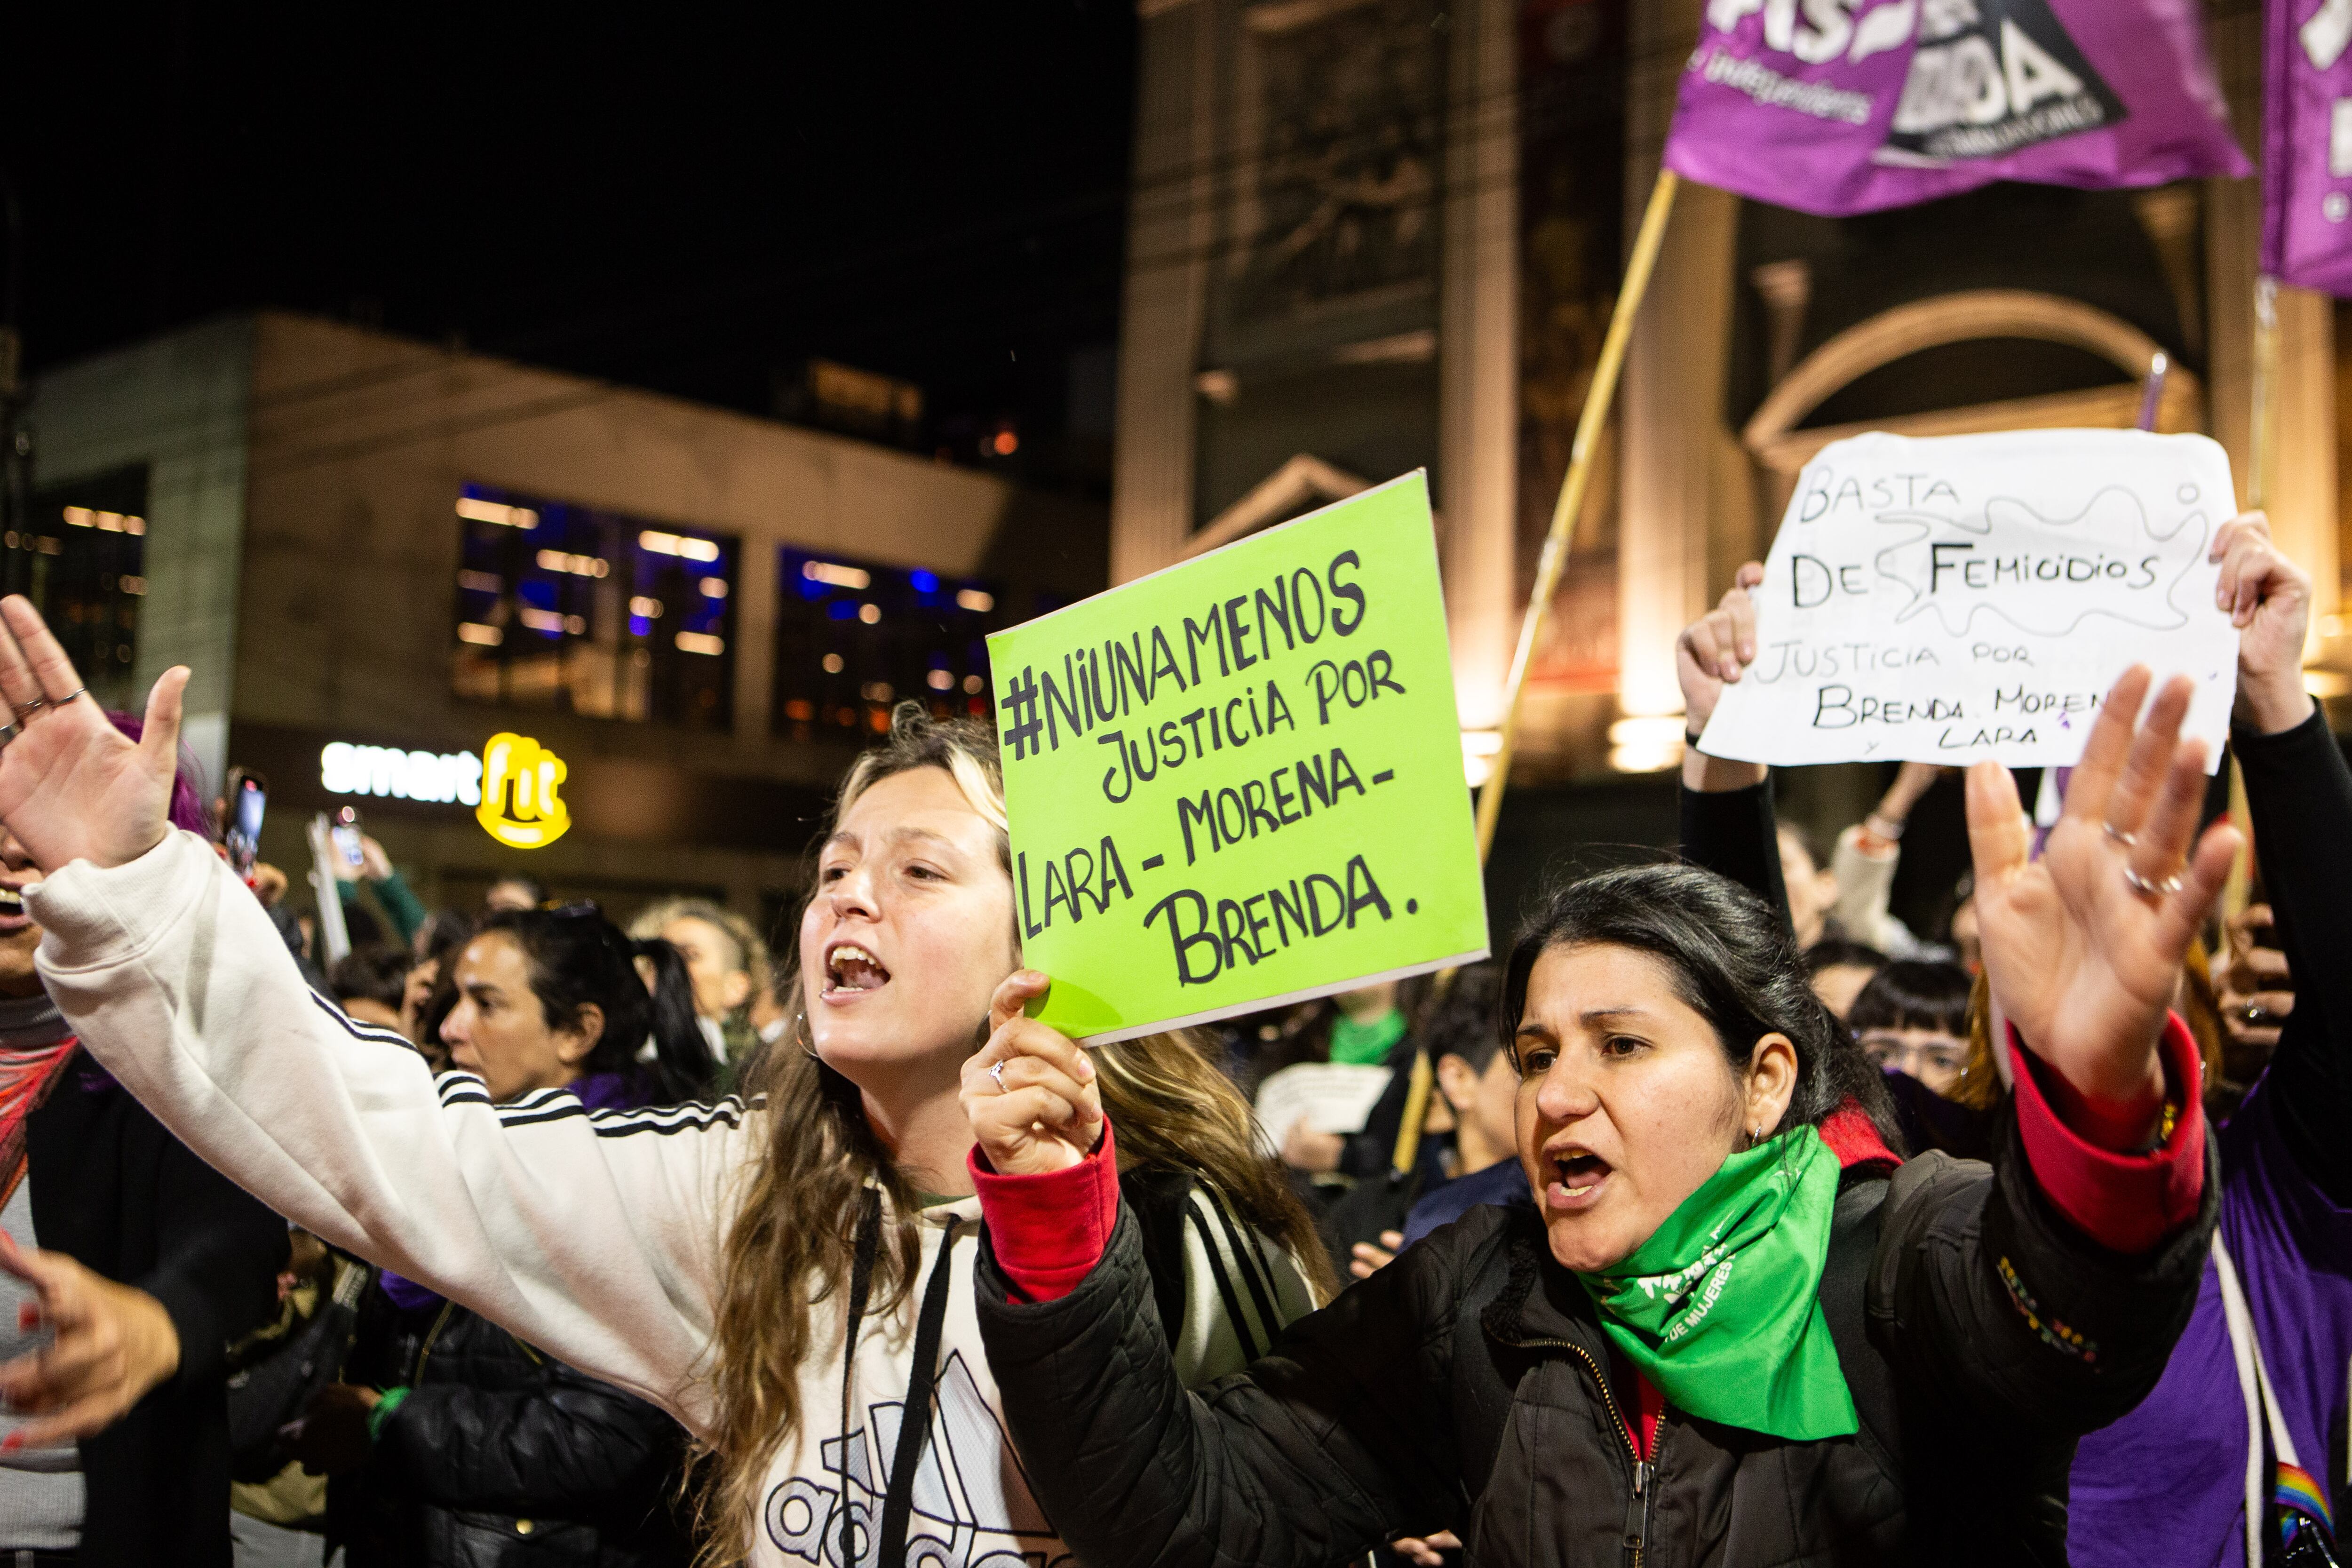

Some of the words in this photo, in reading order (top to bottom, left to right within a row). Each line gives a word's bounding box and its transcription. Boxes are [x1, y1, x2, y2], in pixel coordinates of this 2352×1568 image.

[1799, 464, 1962, 523] BASTA
[1791, 553, 1868, 610] DE
[1971, 642, 2035, 667] POR
[1306, 649, 1406, 726] POR
[1994, 683, 2111, 714] MOREN
[1938, 727, 2038, 751] LARA
[1018, 835, 1134, 940] LARA
[1143, 853, 1418, 988] BRENDA.
[1685, 1261, 1733, 1328] MUJERES
